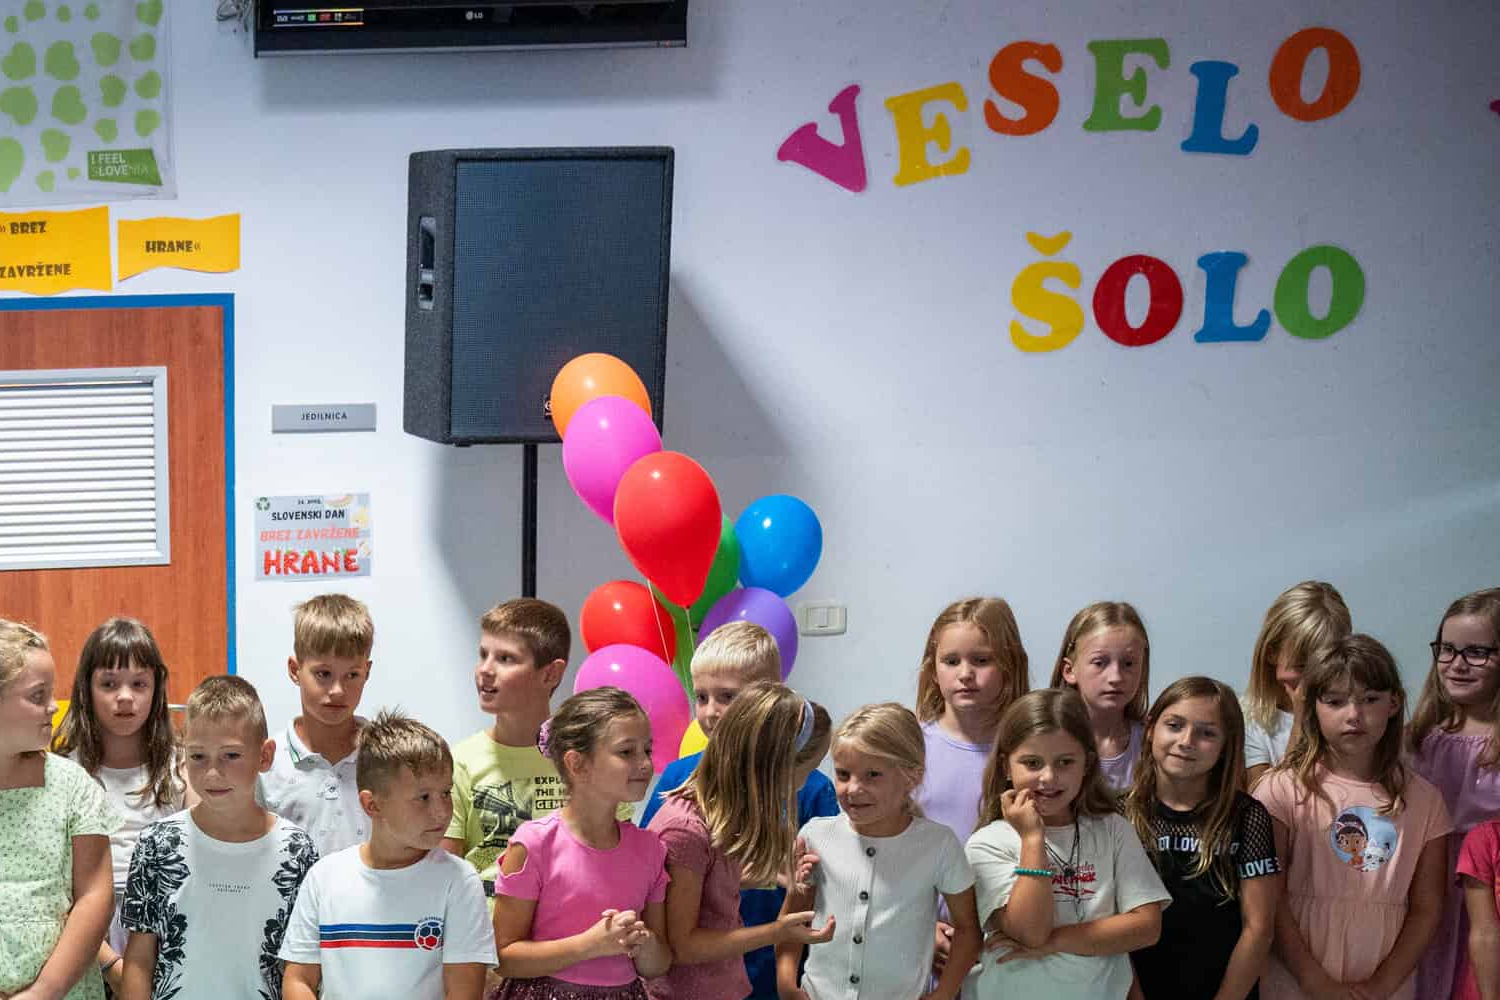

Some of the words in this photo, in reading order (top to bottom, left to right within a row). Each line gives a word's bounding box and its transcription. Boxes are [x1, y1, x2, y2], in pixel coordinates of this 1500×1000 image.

[777, 27, 1361, 193] VESELO
[99, 152, 126, 165] FEEL
[9, 221, 48, 235] BREZ
[1010, 231, 1366, 354] ŠOLO
[301, 412, 348, 421] JEDILNICA
[271, 510, 322, 521] SLOVENSKI
[325, 509, 346, 519] DAN
[260, 530, 291, 542] BREZ
[297, 526, 359, 540] ZAVRŽENE
[263, 547, 360, 576] HRANE
[534, 776, 561, 785] EXPL
[535, 788, 555, 797] THE
